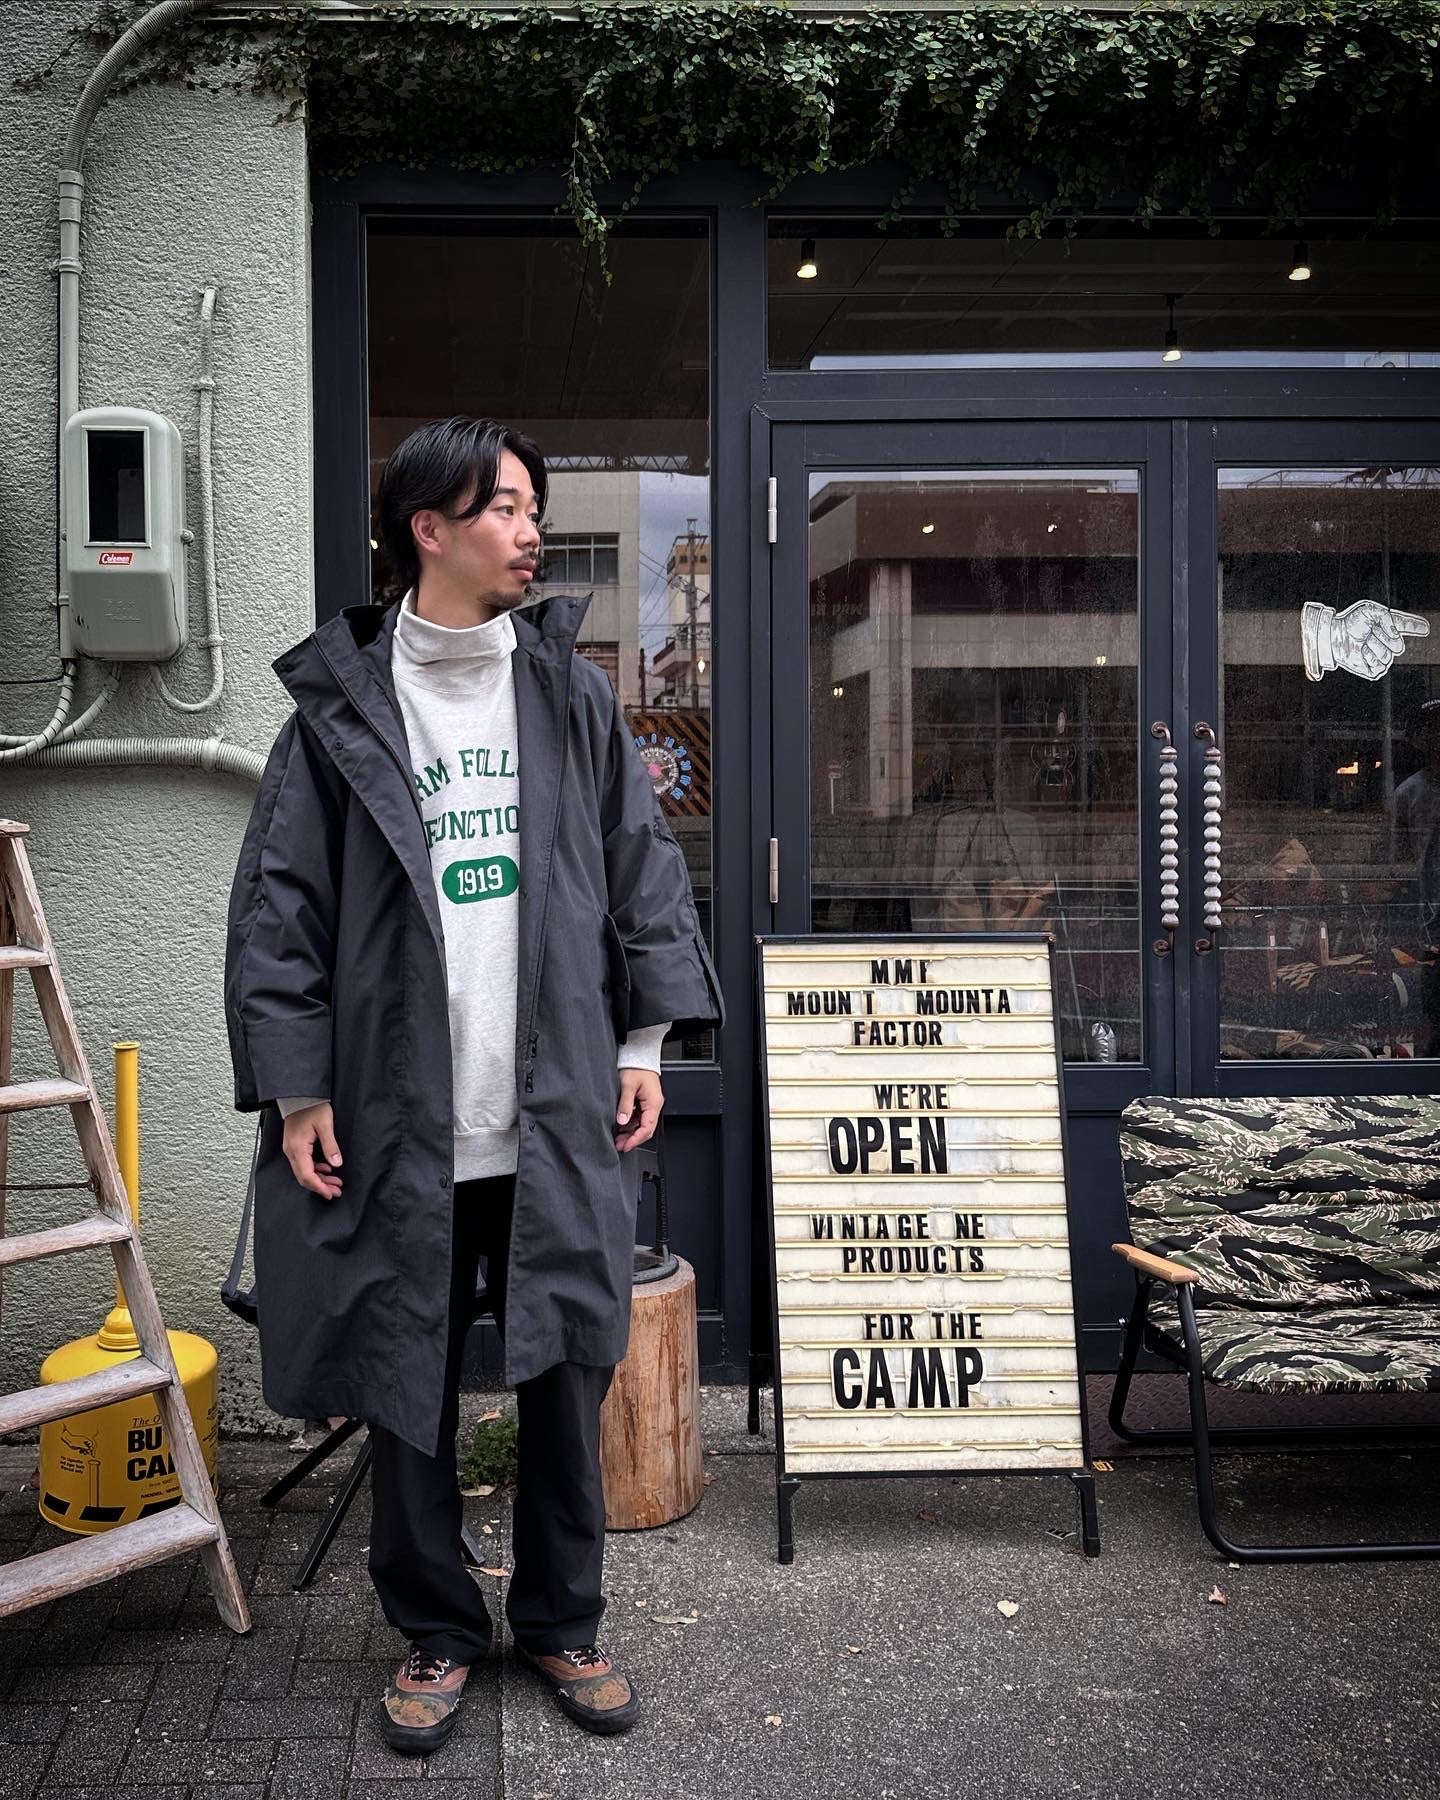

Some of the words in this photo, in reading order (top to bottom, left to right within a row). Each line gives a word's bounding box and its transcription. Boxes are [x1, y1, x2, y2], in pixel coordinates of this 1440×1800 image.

[101, 553, 130, 564] Coleman
[456, 864, 503, 896] 1919
[916, 989, 1011, 1015] MOUNTA
[854, 1021, 942, 1047] FACTOR
[874, 1084, 948, 1109] WE'RE
[829, 1117, 948, 1174] OPEN
[812, 1214, 928, 1239] VINTAGE
[956, 1214, 984, 1239] NE
[843, 1247, 984, 1273] PRODUCTS
[865, 1314, 914, 1340] FOR
[931, 1313, 982, 1339] THE
[833, 1347, 984, 1409] CAMP
[132, 1417, 149, 1427] The
